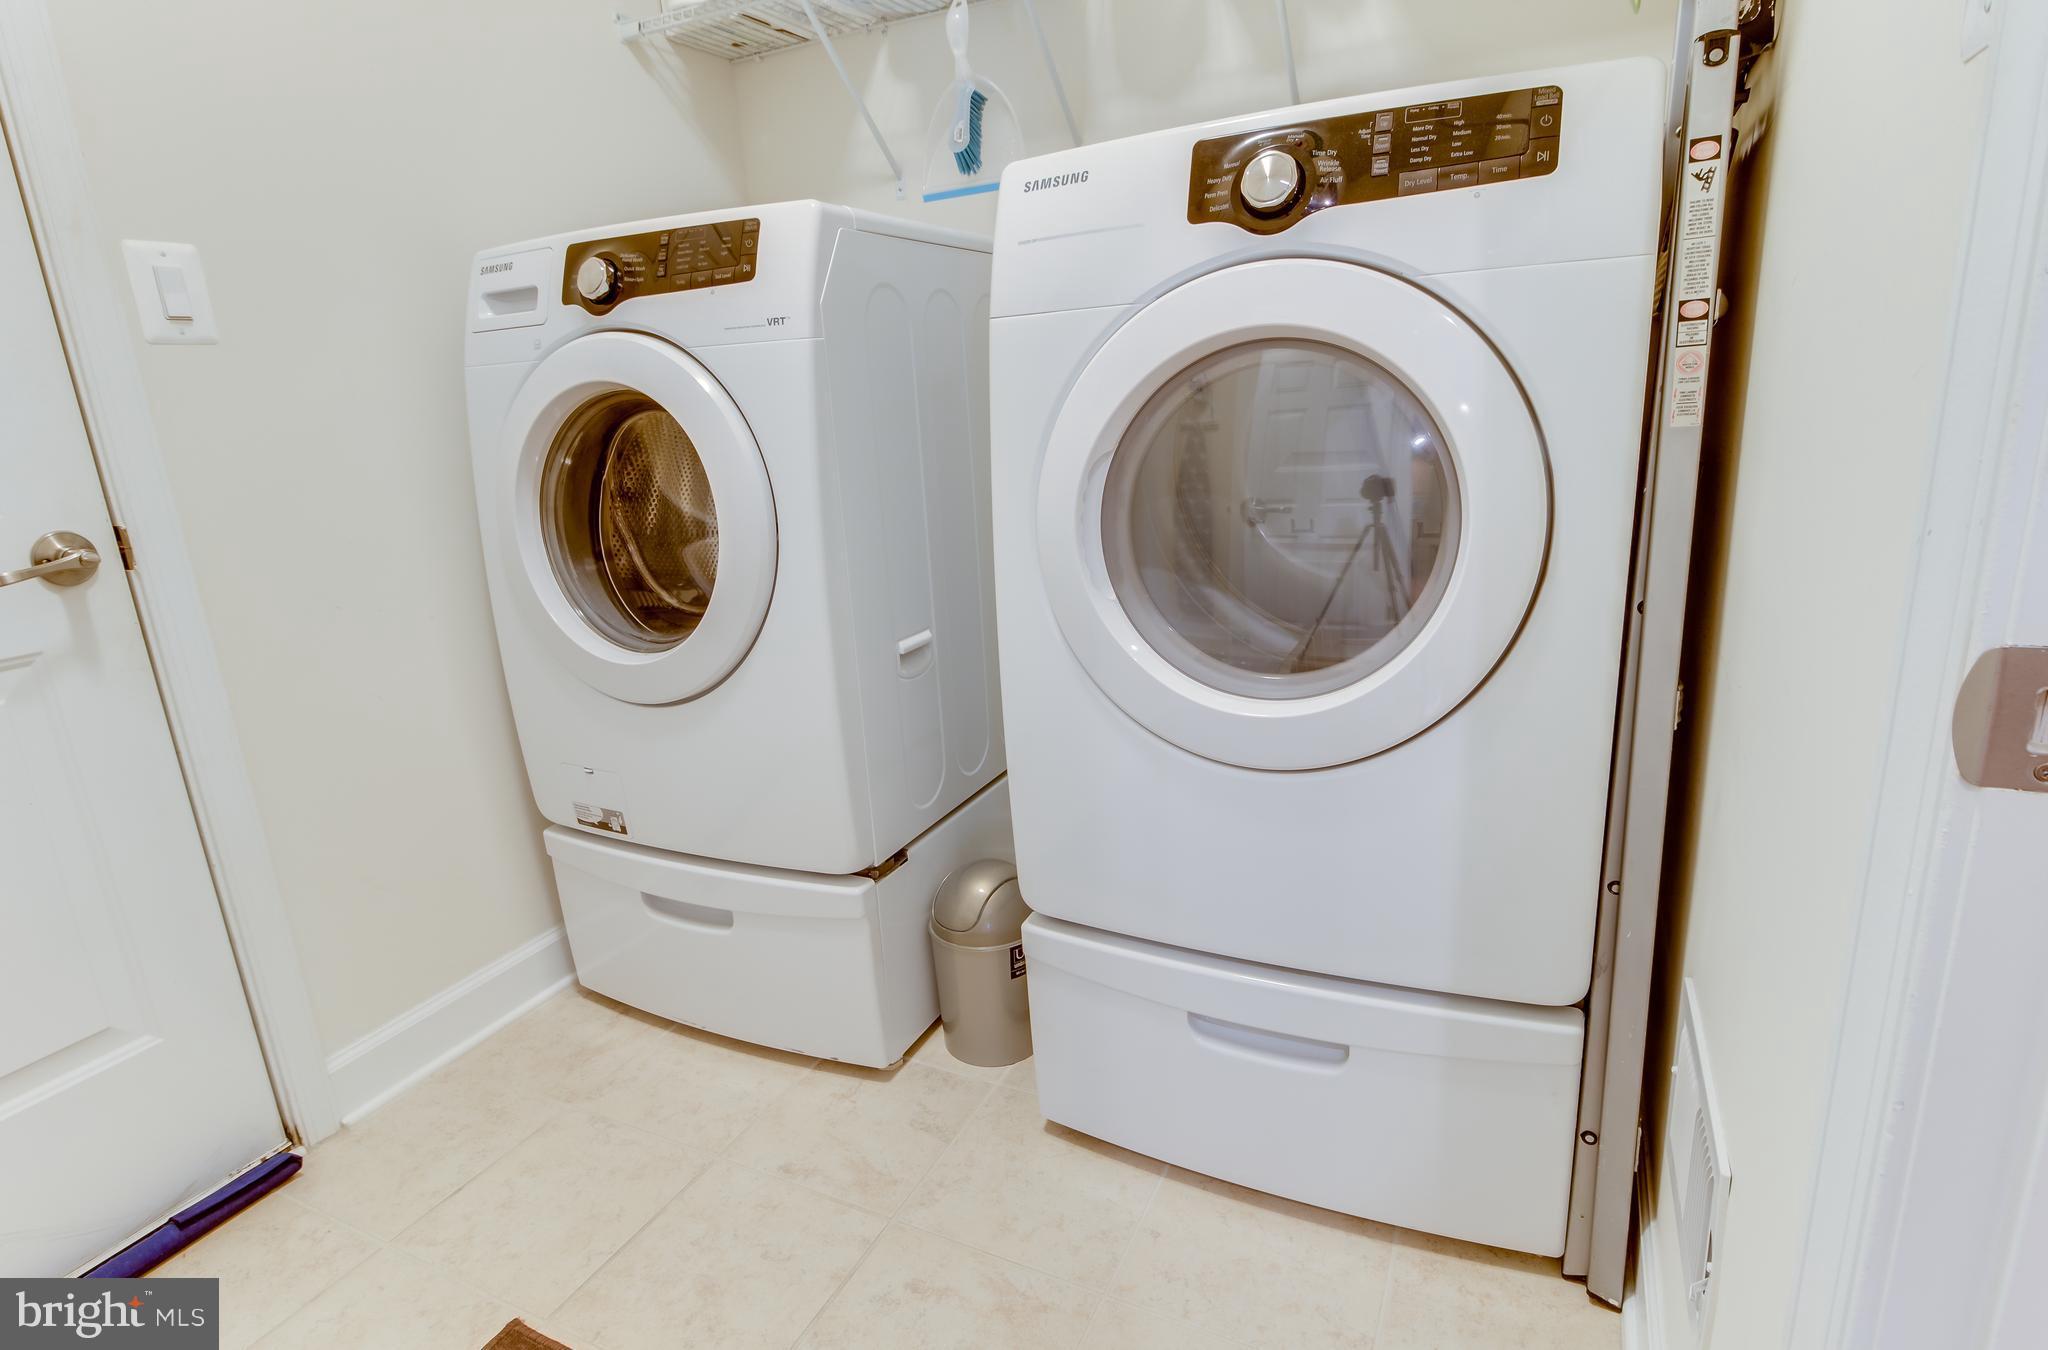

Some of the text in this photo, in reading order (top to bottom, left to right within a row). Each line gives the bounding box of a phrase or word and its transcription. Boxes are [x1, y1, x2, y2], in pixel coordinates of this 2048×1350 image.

[1312, 148, 1337, 157] Time Dry
[1450, 150, 1463, 158] Extra
[1317, 159, 1340, 168] Wrinkle
[1319, 165, 1342, 173] Release
[1491, 166, 1508, 174] Time
[1207, 177, 1221, 185] Heavy
[1450, 172, 1470, 181] Temp.
[1024, 170, 1089, 193] SAMSUNG
[1404, 176, 1433, 187] Dry Level
[1204, 191, 1217, 199] Perm
[480, 261, 513, 276] SAMSUNG
[766, 316, 786, 327] VRT
